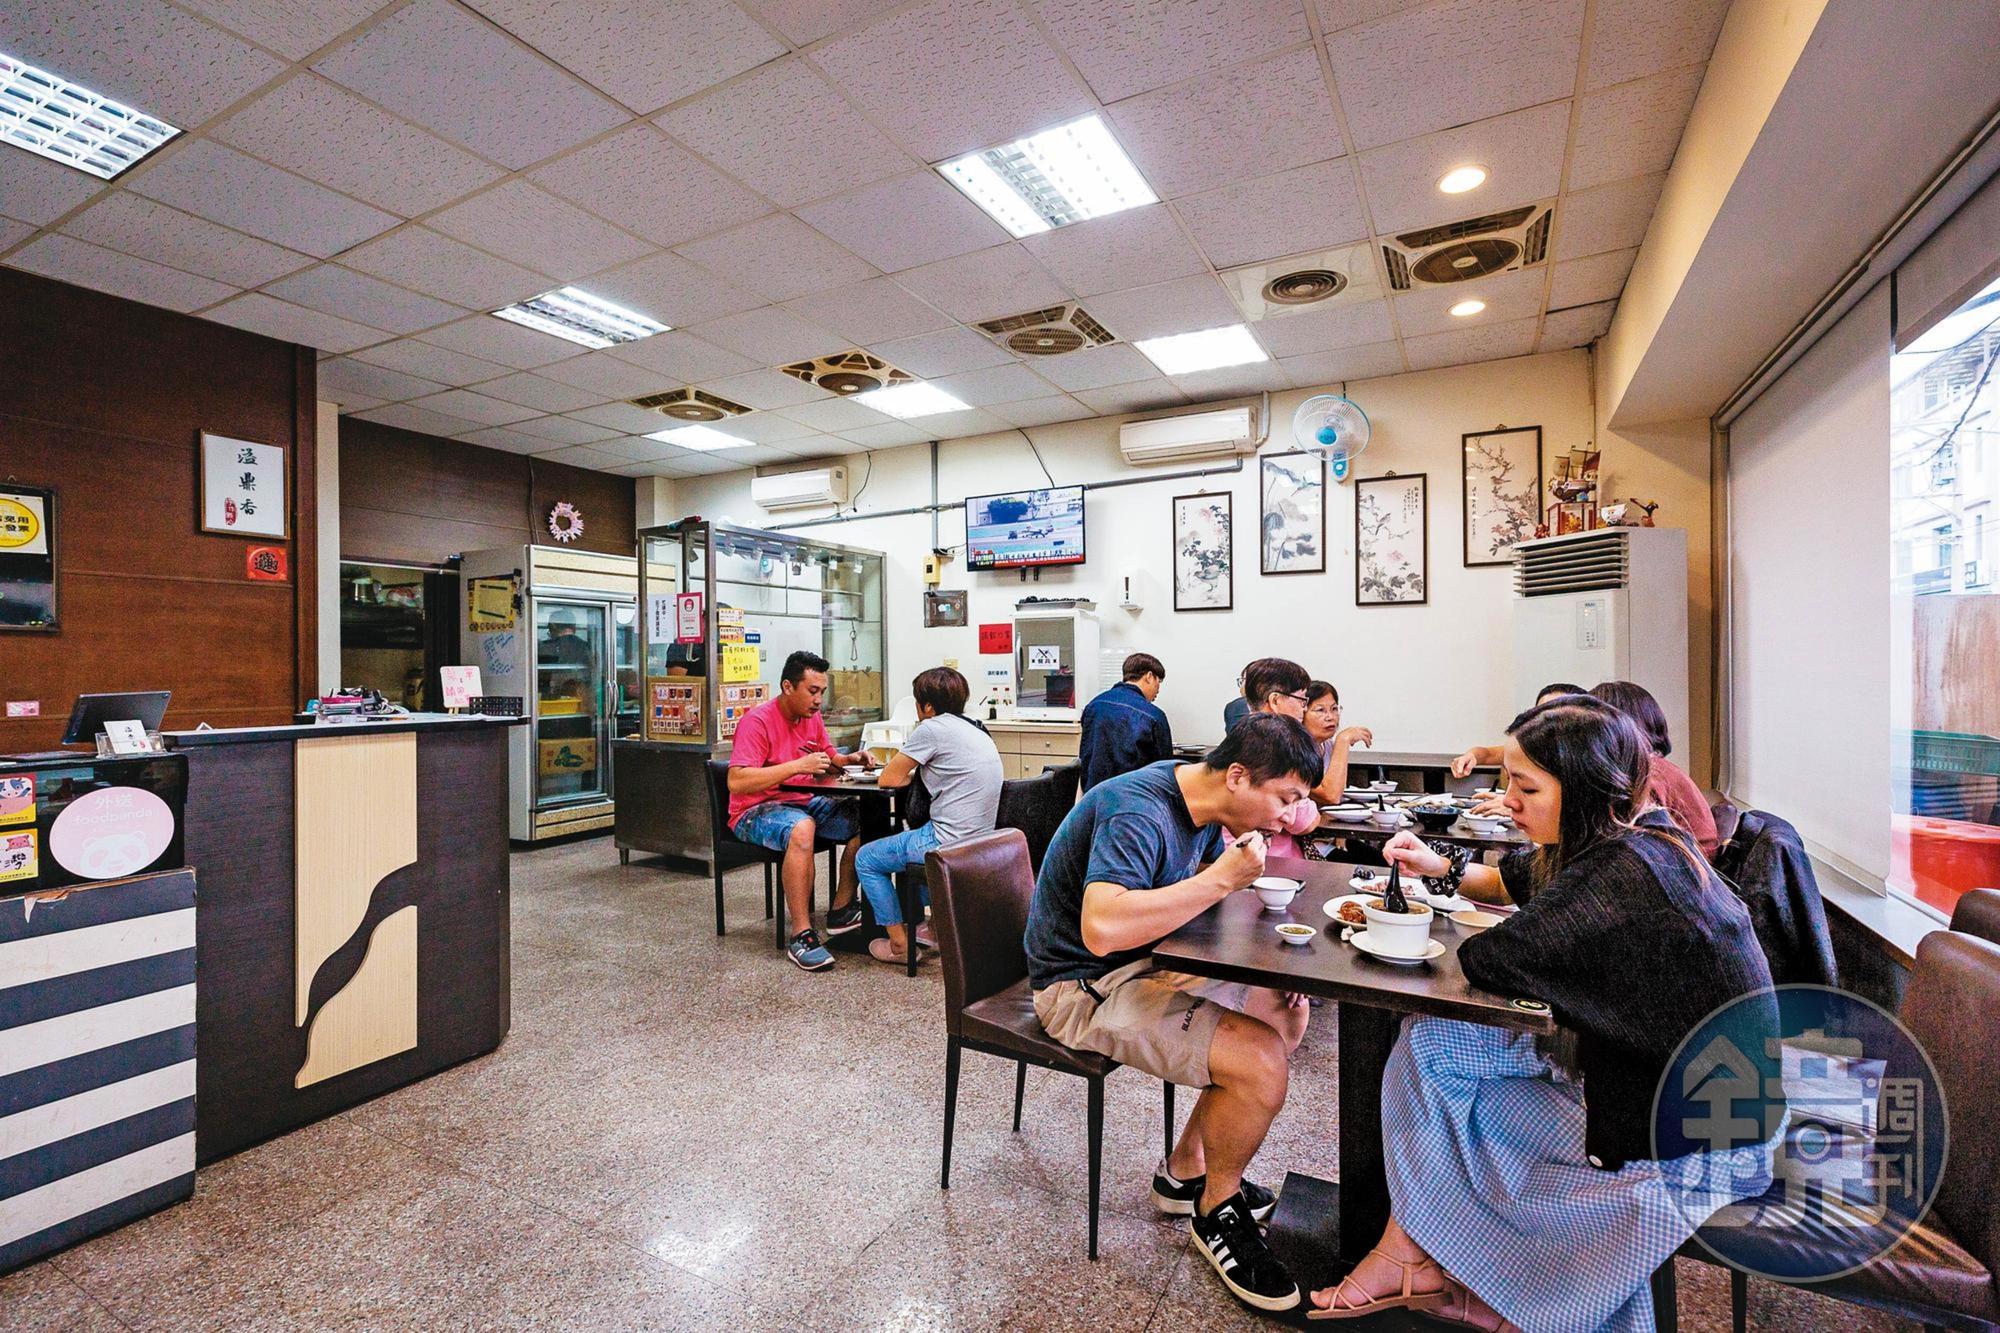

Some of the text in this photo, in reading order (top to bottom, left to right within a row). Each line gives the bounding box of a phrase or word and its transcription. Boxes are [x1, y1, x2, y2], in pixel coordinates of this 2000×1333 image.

[238, 447, 259, 516] 溢鼎香
[0, 515, 29, 524] 免用
[0, 524, 30, 533] 發票
[75, 807, 152, 824] foodpanda
